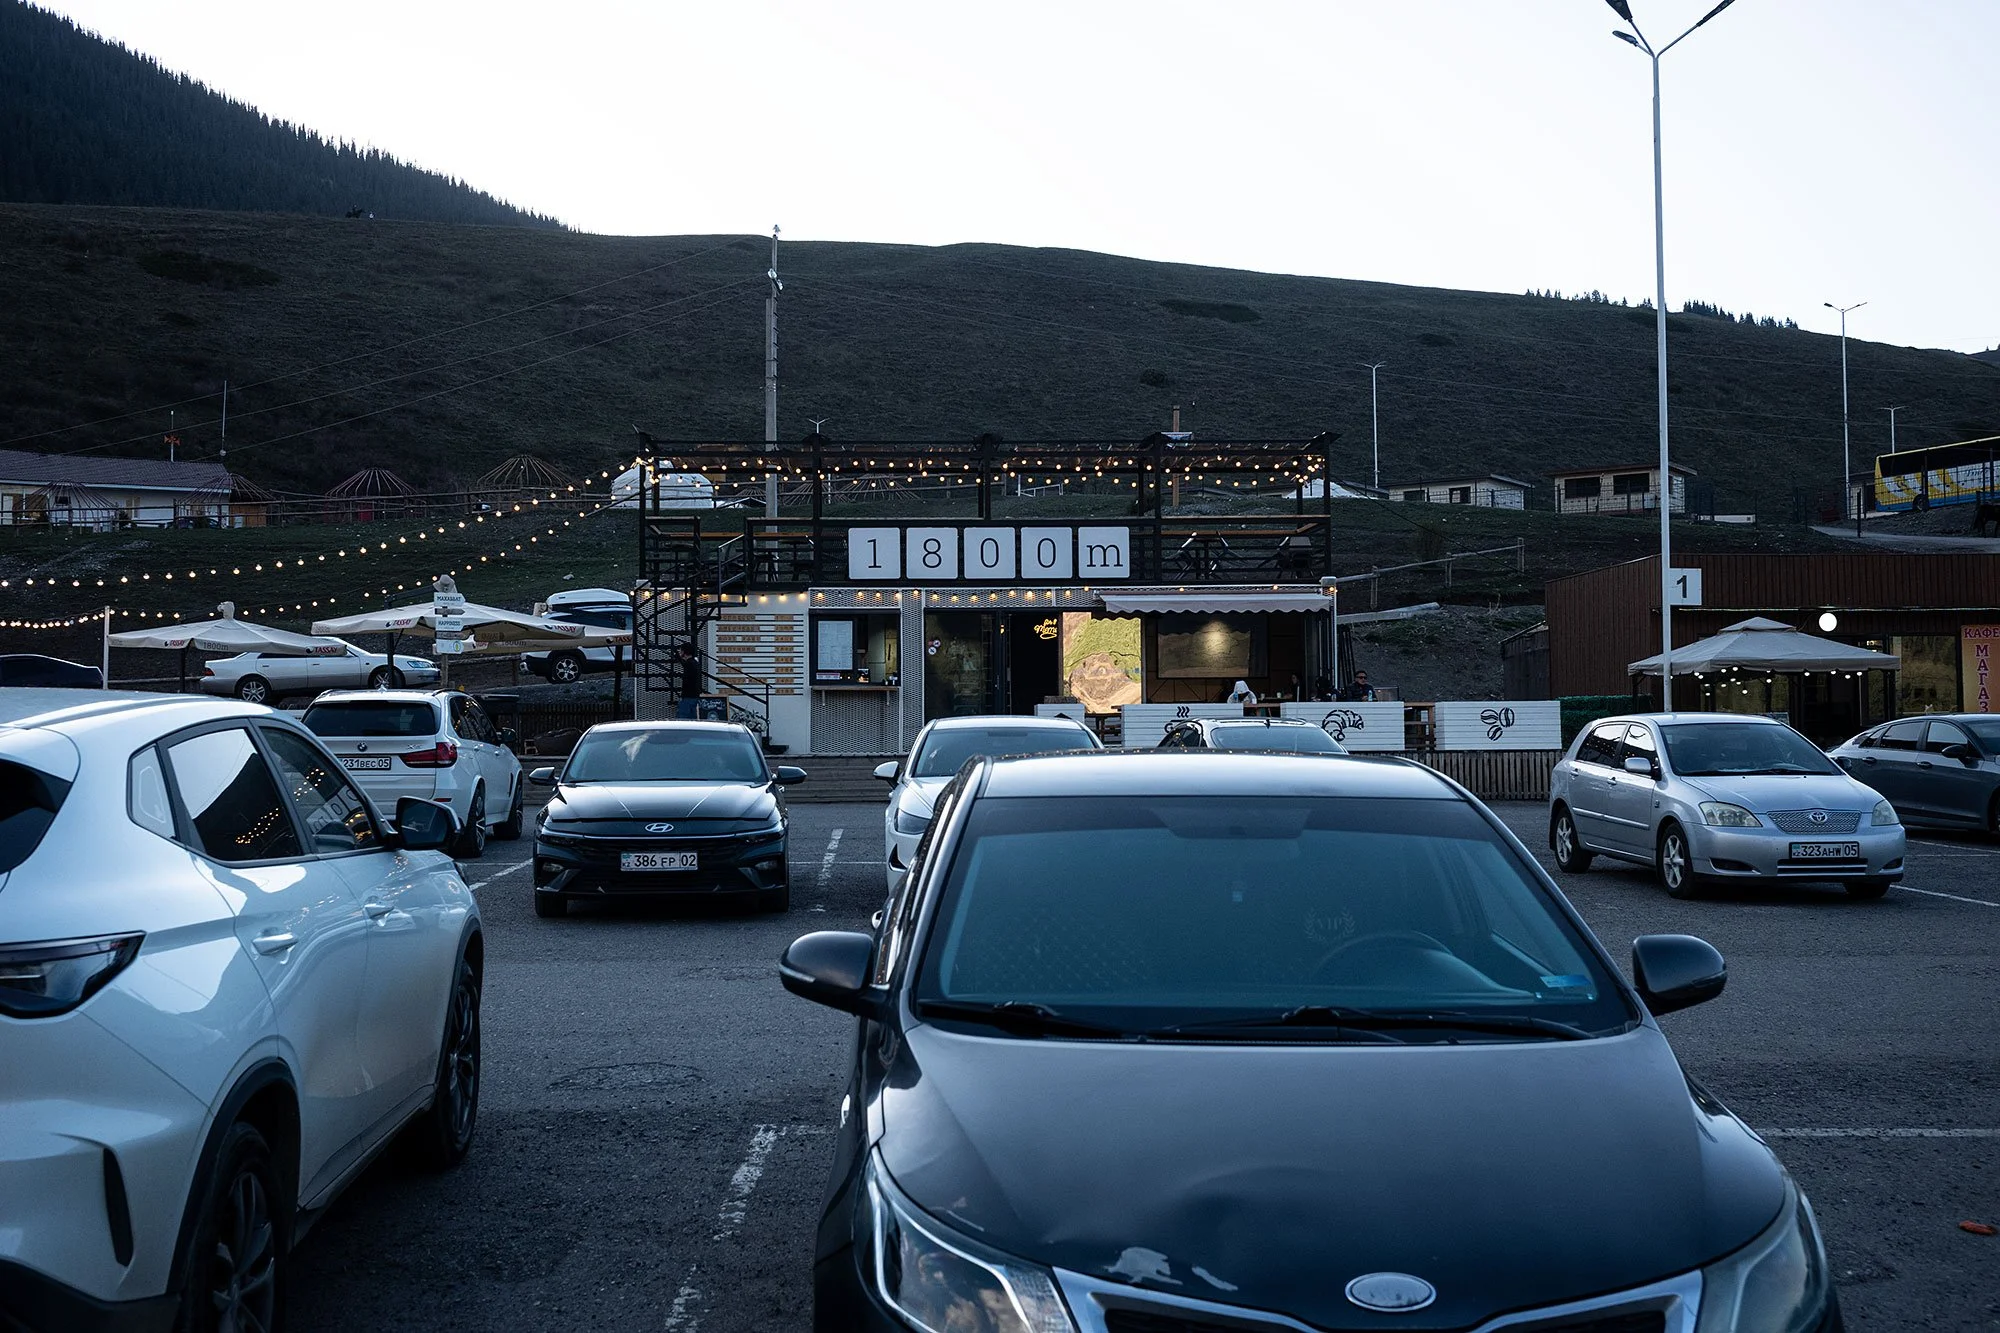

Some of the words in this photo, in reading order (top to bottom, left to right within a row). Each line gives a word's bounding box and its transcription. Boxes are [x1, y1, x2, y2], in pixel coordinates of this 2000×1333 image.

[867, 538, 1123, 568] 1800m
[1677, 575, 1687, 599] 1
[1964, 628, 1999, 638] КАФЕ
[203, 641, 229, 651] 1800m
[315, 646, 337, 654] TASSAY
[378, 759, 390, 768] 05
[1844, 845, 1857, 856] 05
[634, 854, 657, 867] 386
[661, 857, 676, 867] FP
[681, 854, 696, 867] 02
